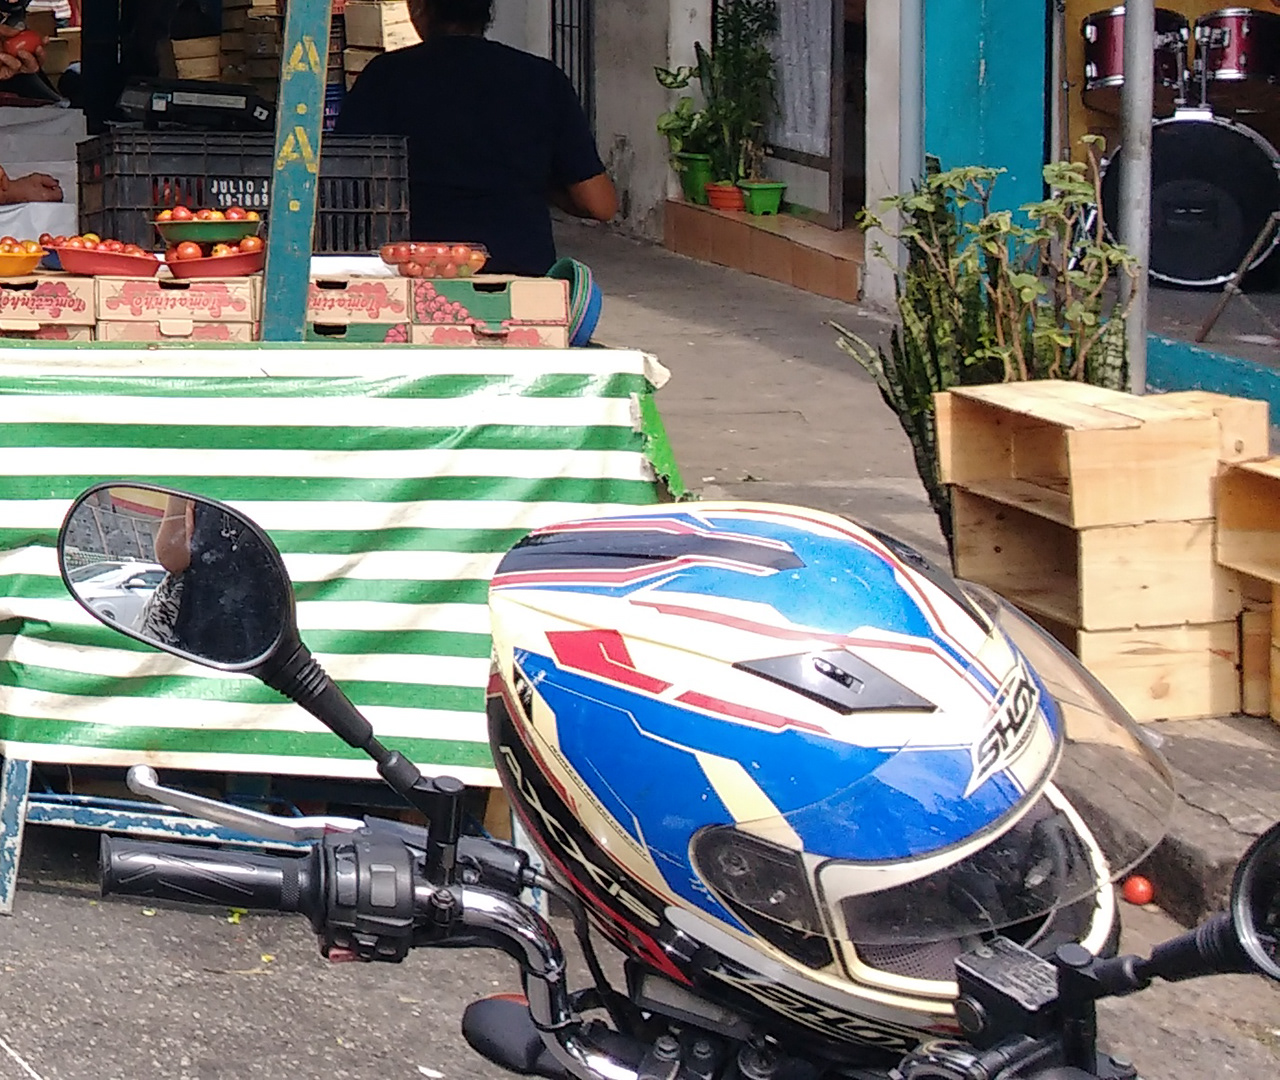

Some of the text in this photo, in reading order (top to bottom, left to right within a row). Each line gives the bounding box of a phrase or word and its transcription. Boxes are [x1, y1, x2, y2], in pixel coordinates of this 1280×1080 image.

[211, 179, 269, 194] JULIO J
[132, 295, 217, 312] Tomatinho
[308, 295, 377, 312] Tomatin
